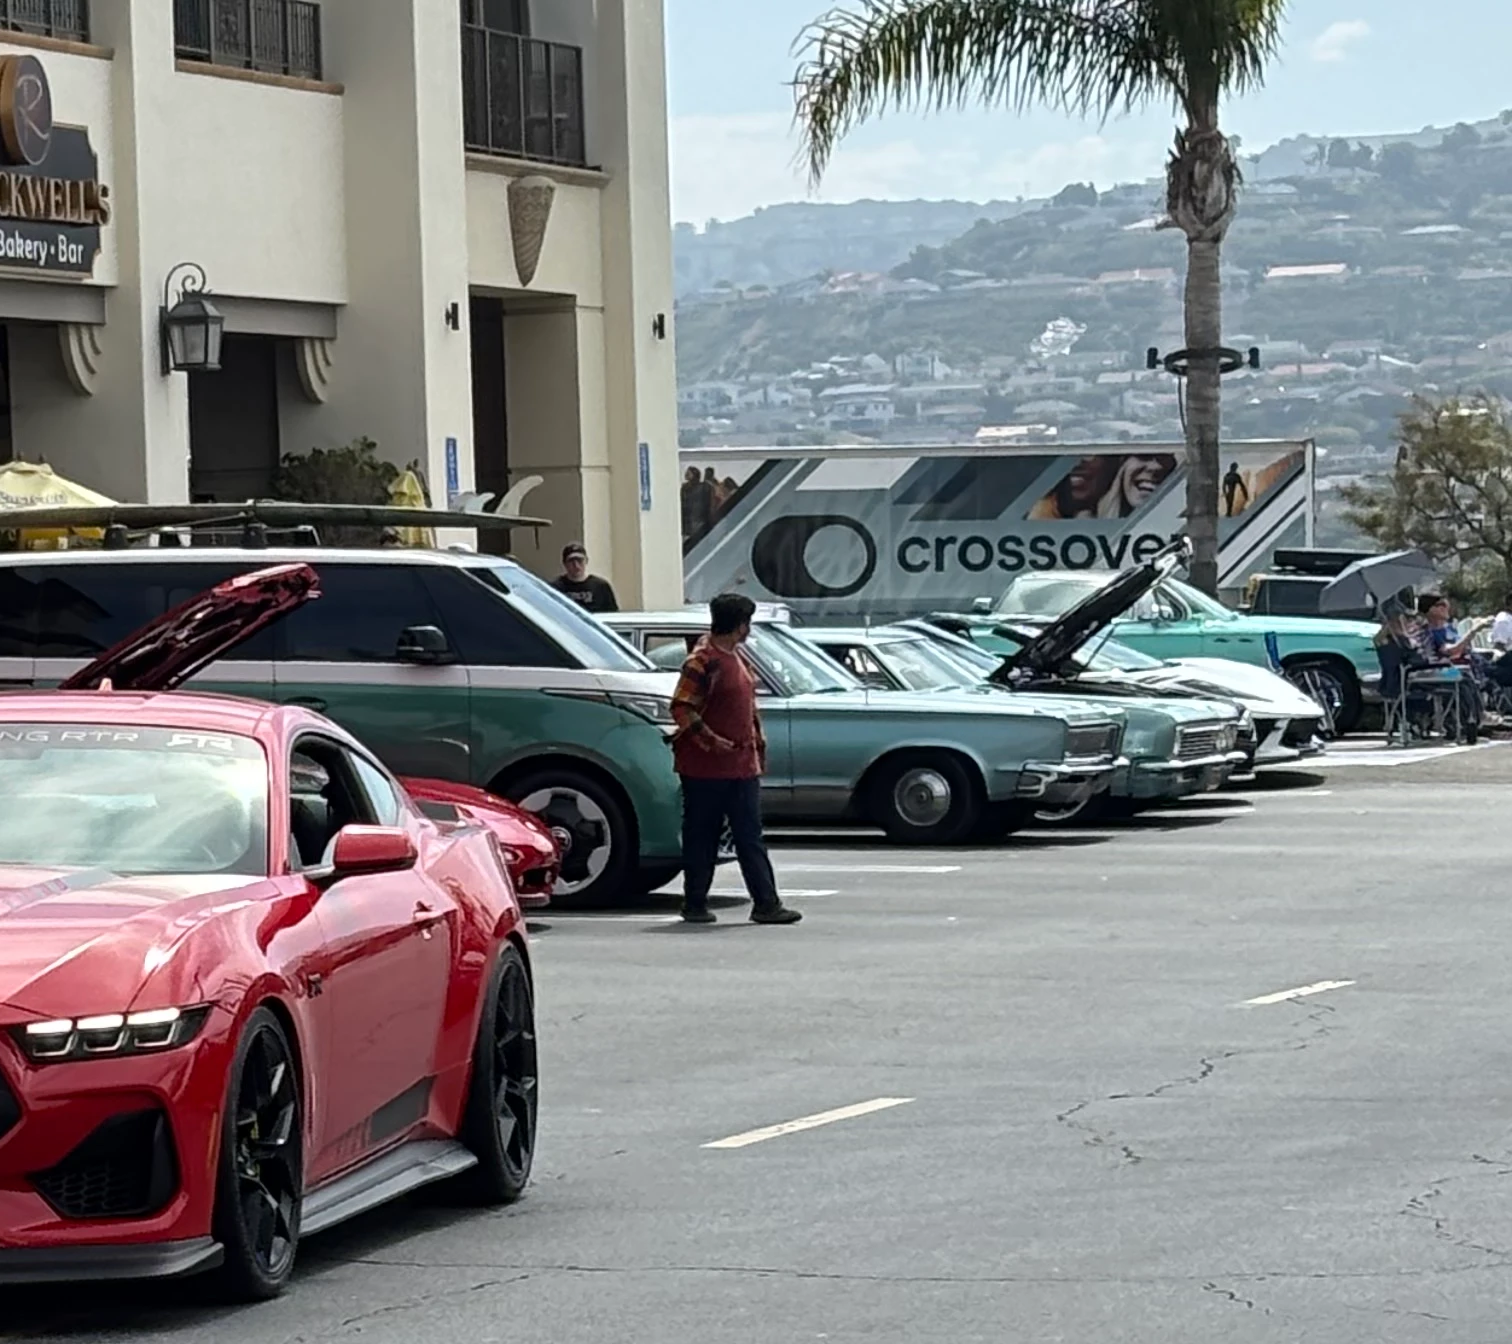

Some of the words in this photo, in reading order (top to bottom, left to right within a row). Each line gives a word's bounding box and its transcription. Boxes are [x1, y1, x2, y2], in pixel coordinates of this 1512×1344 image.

[17, 74, 49, 144] R
[58, 234, 84, 264] Bar
[897, 532, 1187, 574] crossove
[60, 731, 139, 742] RTR
